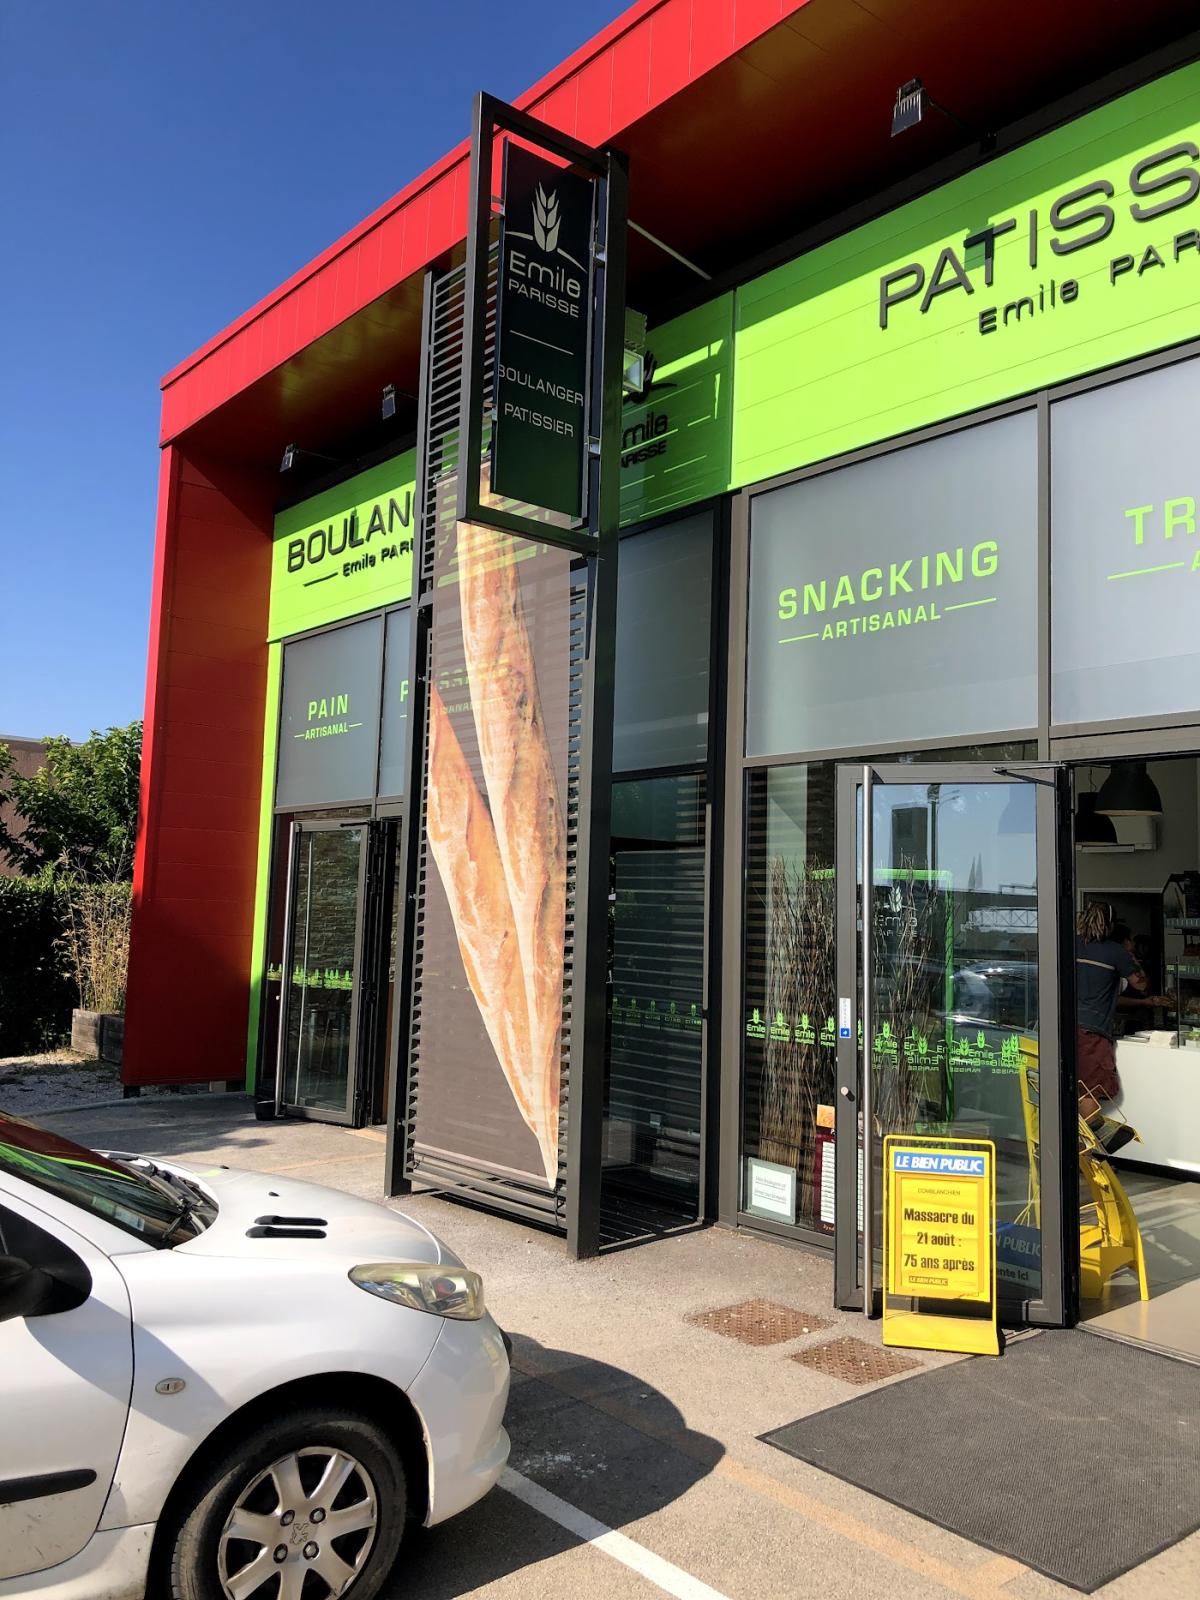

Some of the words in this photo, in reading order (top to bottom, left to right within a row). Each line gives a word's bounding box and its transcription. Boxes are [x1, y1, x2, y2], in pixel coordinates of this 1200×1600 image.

[878, 142, 1200, 330] PATISS
[510, 250, 581, 299] Emile
[979, 279, 1079, 335] Emile
[1110, 229, 1200, 286] PAR
[509, 278, 580, 318] PARISSE
[498, 363, 584, 407] BOULANGER
[504, 402, 574, 438] PATISSIER
[622, 411, 668, 450] mile
[620, 439, 667, 468] RISSE
[287, 490, 416, 574] BOULAN
[1125, 496, 1197, 546] TR
[342, 553, 377, 578] Emile
[778, 540, 999, 620] SNACKING
[821, 603, 941, 641] ARTISANAL
[307, 694, 349, 721] PAIN
[304, 722, 349, 741] ARTISANAL
[895, 1155, 911, 1169] LE
[911, 1156, 940, 1170] BIEN
[940, 1158, 983, 1173] PUBLIC
[904, 1208, 958, 1224] Massacre
[961, 1212, 975, 1225] du
[917, 1231, 929, 1245] 21
[931, 1233, 956, 1247] août
[904, 1254, 918, 1268] 75
[920, 1257, 940, 1269] ans
[943, 1258, 975, 1272] après
